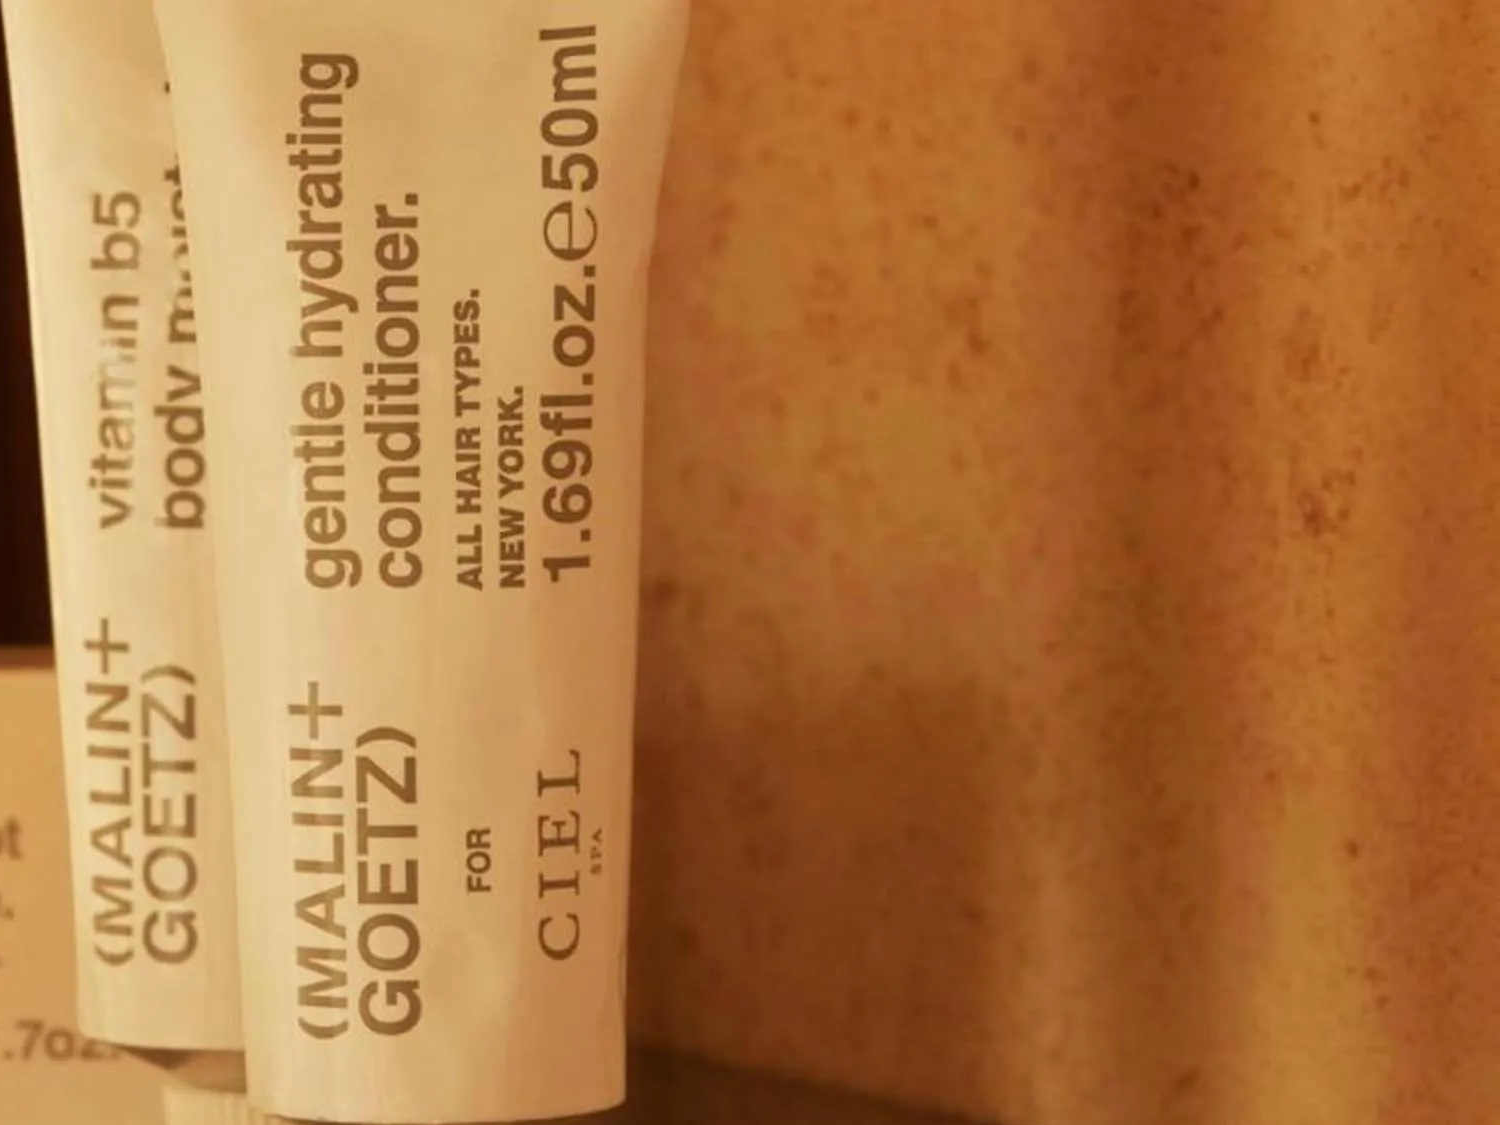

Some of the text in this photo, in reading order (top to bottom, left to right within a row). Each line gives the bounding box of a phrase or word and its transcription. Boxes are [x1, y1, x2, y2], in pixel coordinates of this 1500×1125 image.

[88, 192, 142, 529] vitamin b5
[153, 364, 206, 530] body
[285, 53, 361, 589] gentle hydrating
[363, 192, 423, 588] conditioner.
[453, 289, 483, 591] ALL HAIR TYPES.
[498, 386, 525, 588] NEW YORK.
[83, 618, 134, 967] (MALIN+
[141, 665, 198, 964] GOETZ)
[287, 682, 349, 1040] (MALIN+
[356, 727, 422, 1036] GOETZ)
[466, 828, 491, 893] FOR
[537, 749, 580, 961] CIEL
[590, 828, 602, 875] SPA
